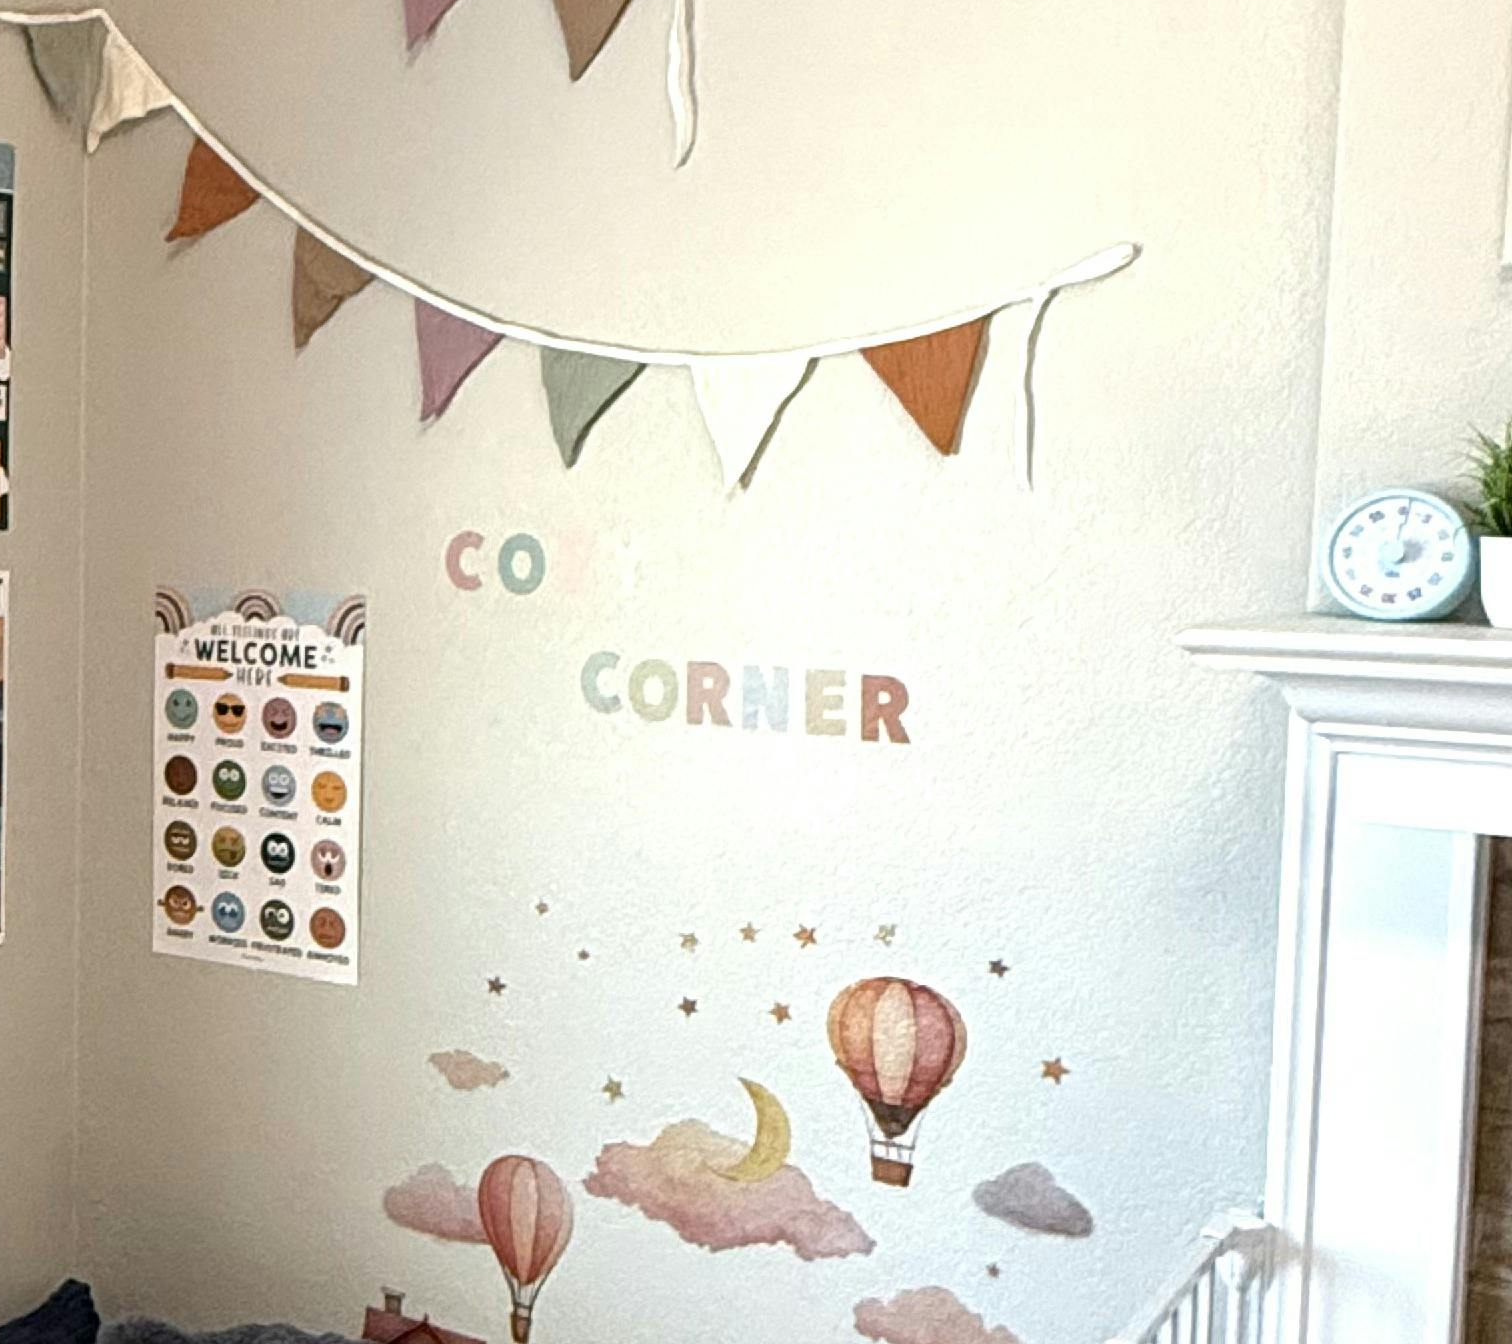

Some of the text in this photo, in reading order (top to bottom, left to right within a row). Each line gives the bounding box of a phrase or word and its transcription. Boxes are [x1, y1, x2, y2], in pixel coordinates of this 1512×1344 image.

[444, 530, 545, 596] CO
[194, 638, 318, 669] WELCOME
[237, 667, 273, 687] HERE
[580, 650, 911, 744] CORNER
